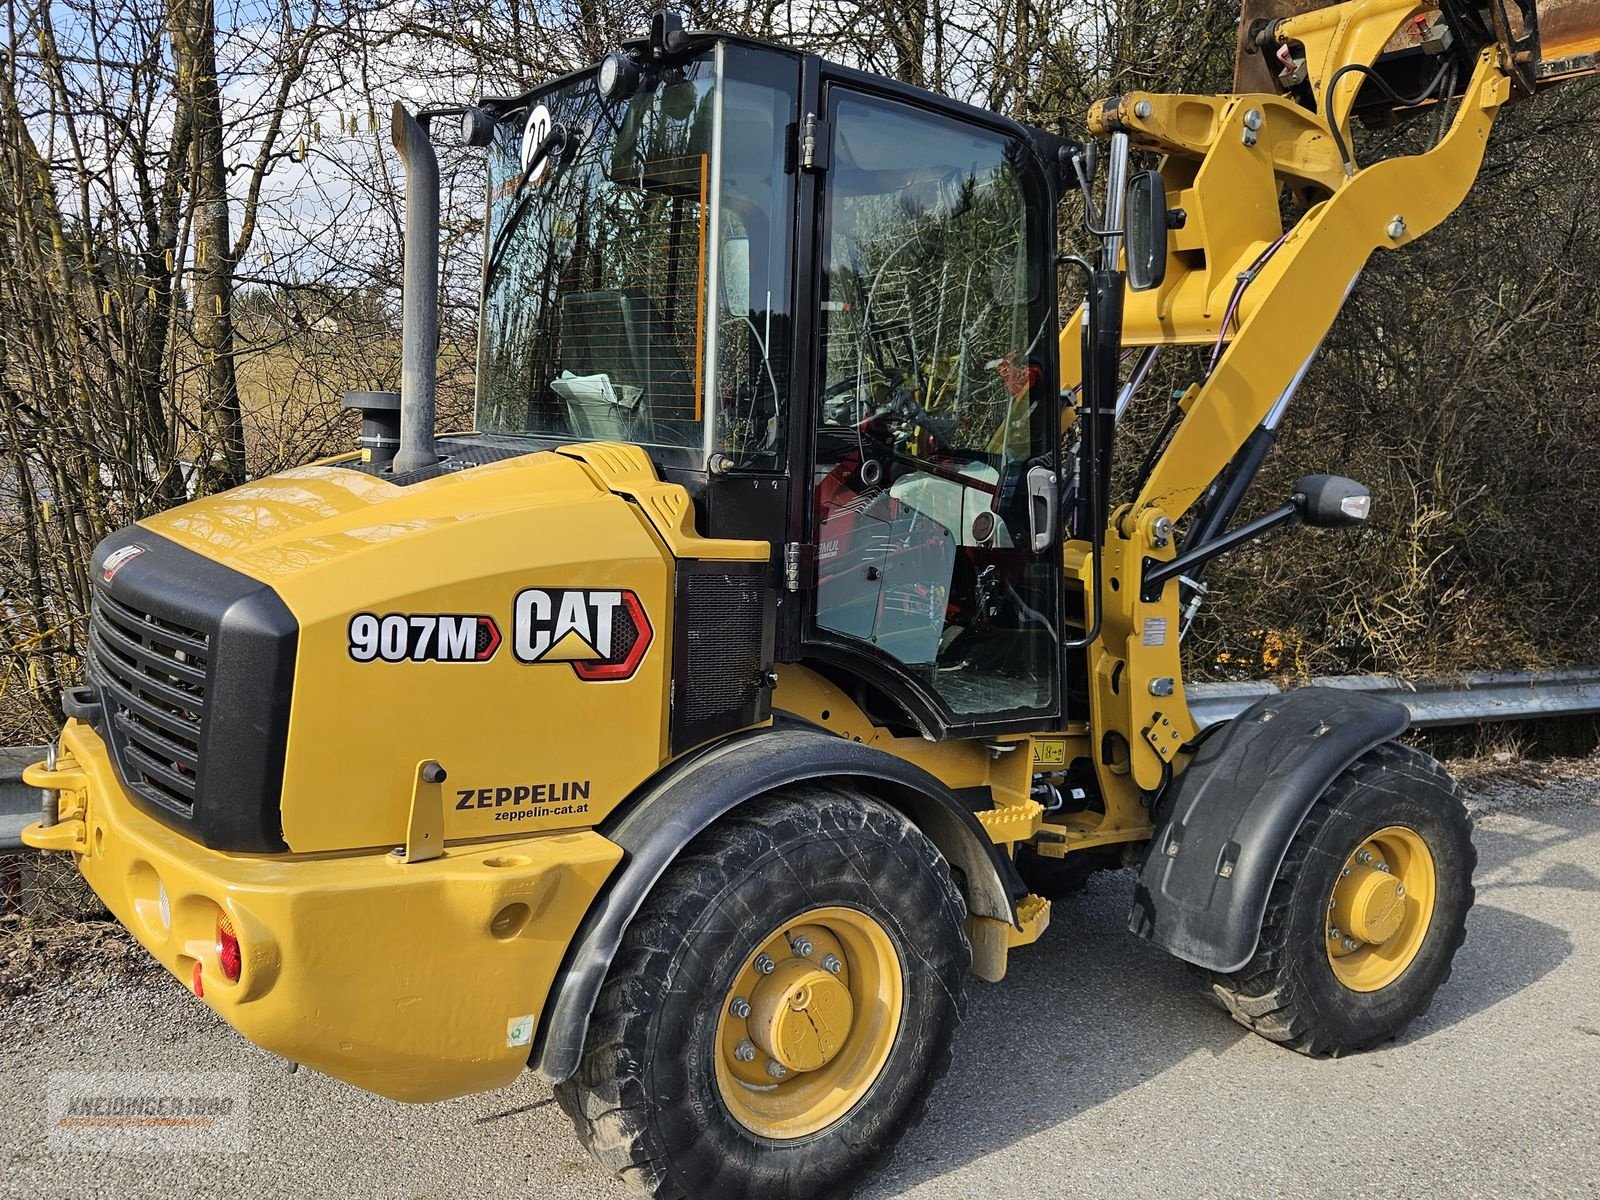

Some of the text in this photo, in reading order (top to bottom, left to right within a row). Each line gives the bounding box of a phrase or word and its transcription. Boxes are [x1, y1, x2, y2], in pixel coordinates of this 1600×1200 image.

[350, 615, 478, 660] 907M
[515, 589, 622, 662] CAT
[455, 780, 591, 811] ZEPPELIN
[494, 803, 589, 822] zeppelin-cat.at
